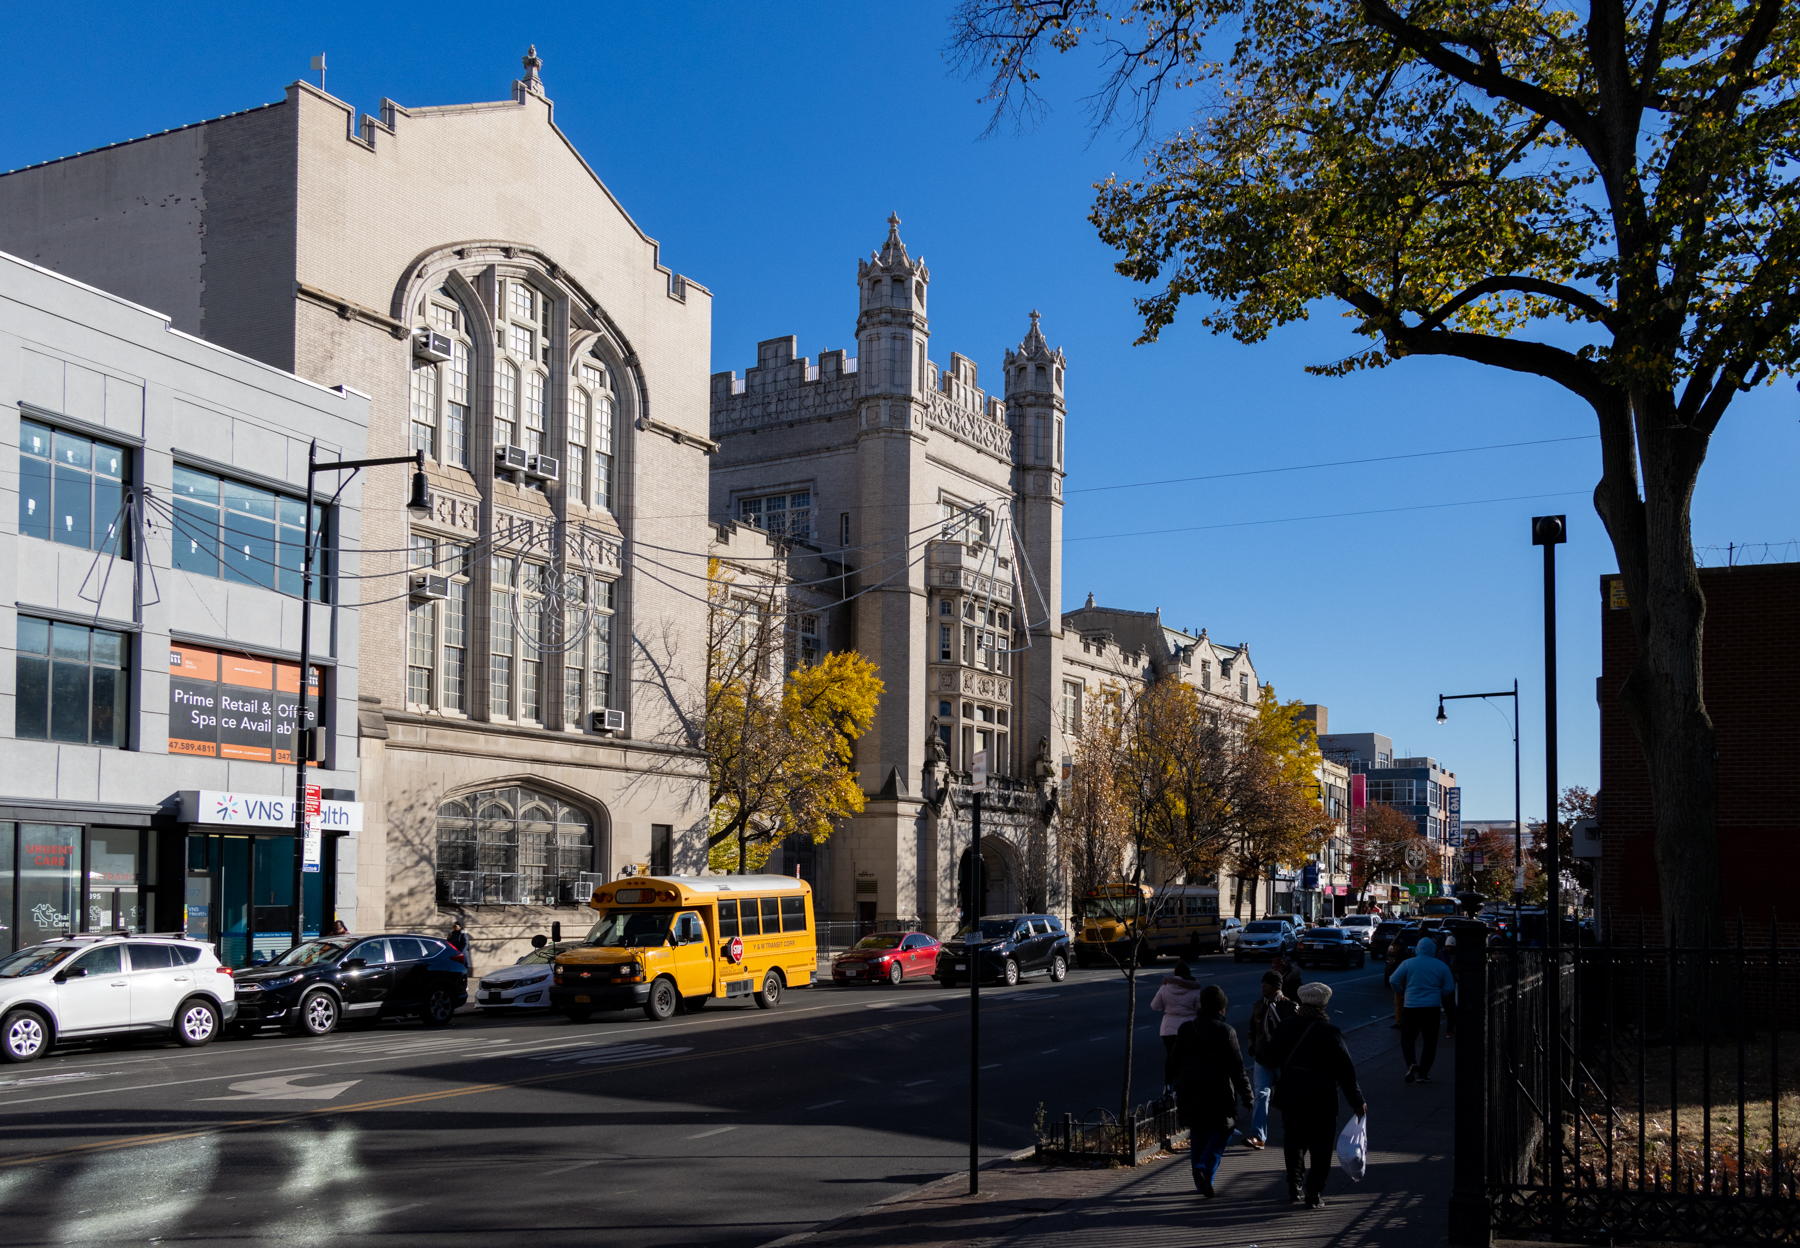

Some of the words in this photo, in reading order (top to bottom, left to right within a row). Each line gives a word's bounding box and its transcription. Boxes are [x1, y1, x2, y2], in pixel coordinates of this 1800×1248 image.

[174, 689, 214, 707] Prime
[221, 696, 258, 713] Retail
[261, 702, 272, 715] &
[277, 704, 315, 721] Offe
[191, 710, 237, 729] Space
[240, 717, 295, 735] Availab
[168, 741, 215, 753] 47.589.4811
[1450, 788, 1460, 811] five
[244, 799, 284, 821] VNS
[291, 803, 349, 826] alth
[26, 844, 75, 855] URGENT
[34, 856, 66, 866] CARE
[89, 872, 141, 881] TRANCE
[1416, 885, 1428, 894] TD
[641, 890, 654, 901] BUS
[733, 944, 742, 954] STOP
[765, 941, 783, 949] TRANSIT
